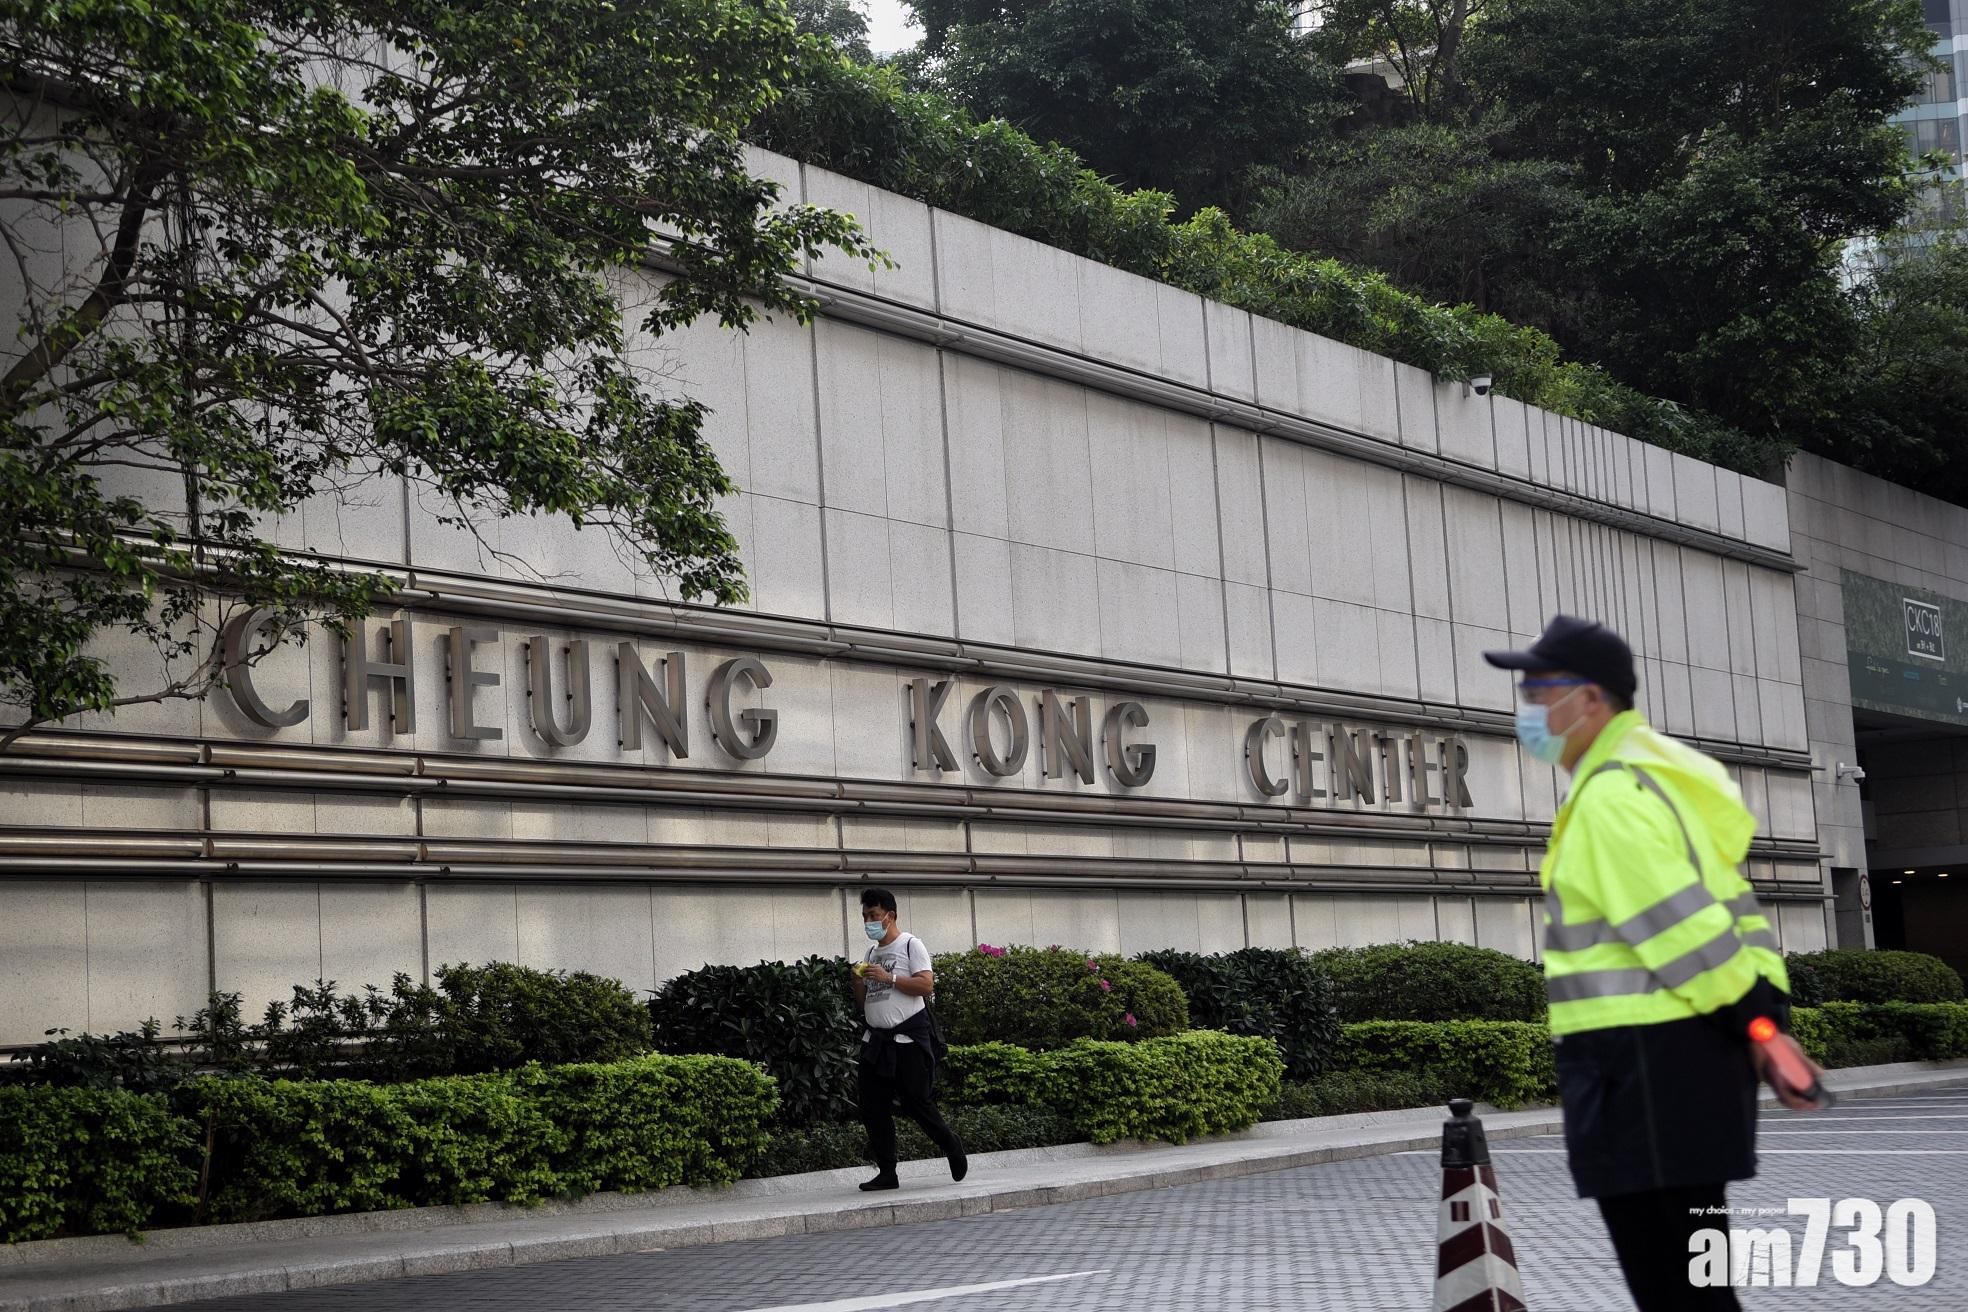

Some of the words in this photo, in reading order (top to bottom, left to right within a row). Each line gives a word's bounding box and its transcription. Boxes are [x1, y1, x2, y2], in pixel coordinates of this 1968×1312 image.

[1907, 605, 1940, 638] CKC18
[224, 606, 778, 760] CHEUNG
[911, 678, 1156, 788] KONG
[1247, 717, 1474, 808] CENTER
